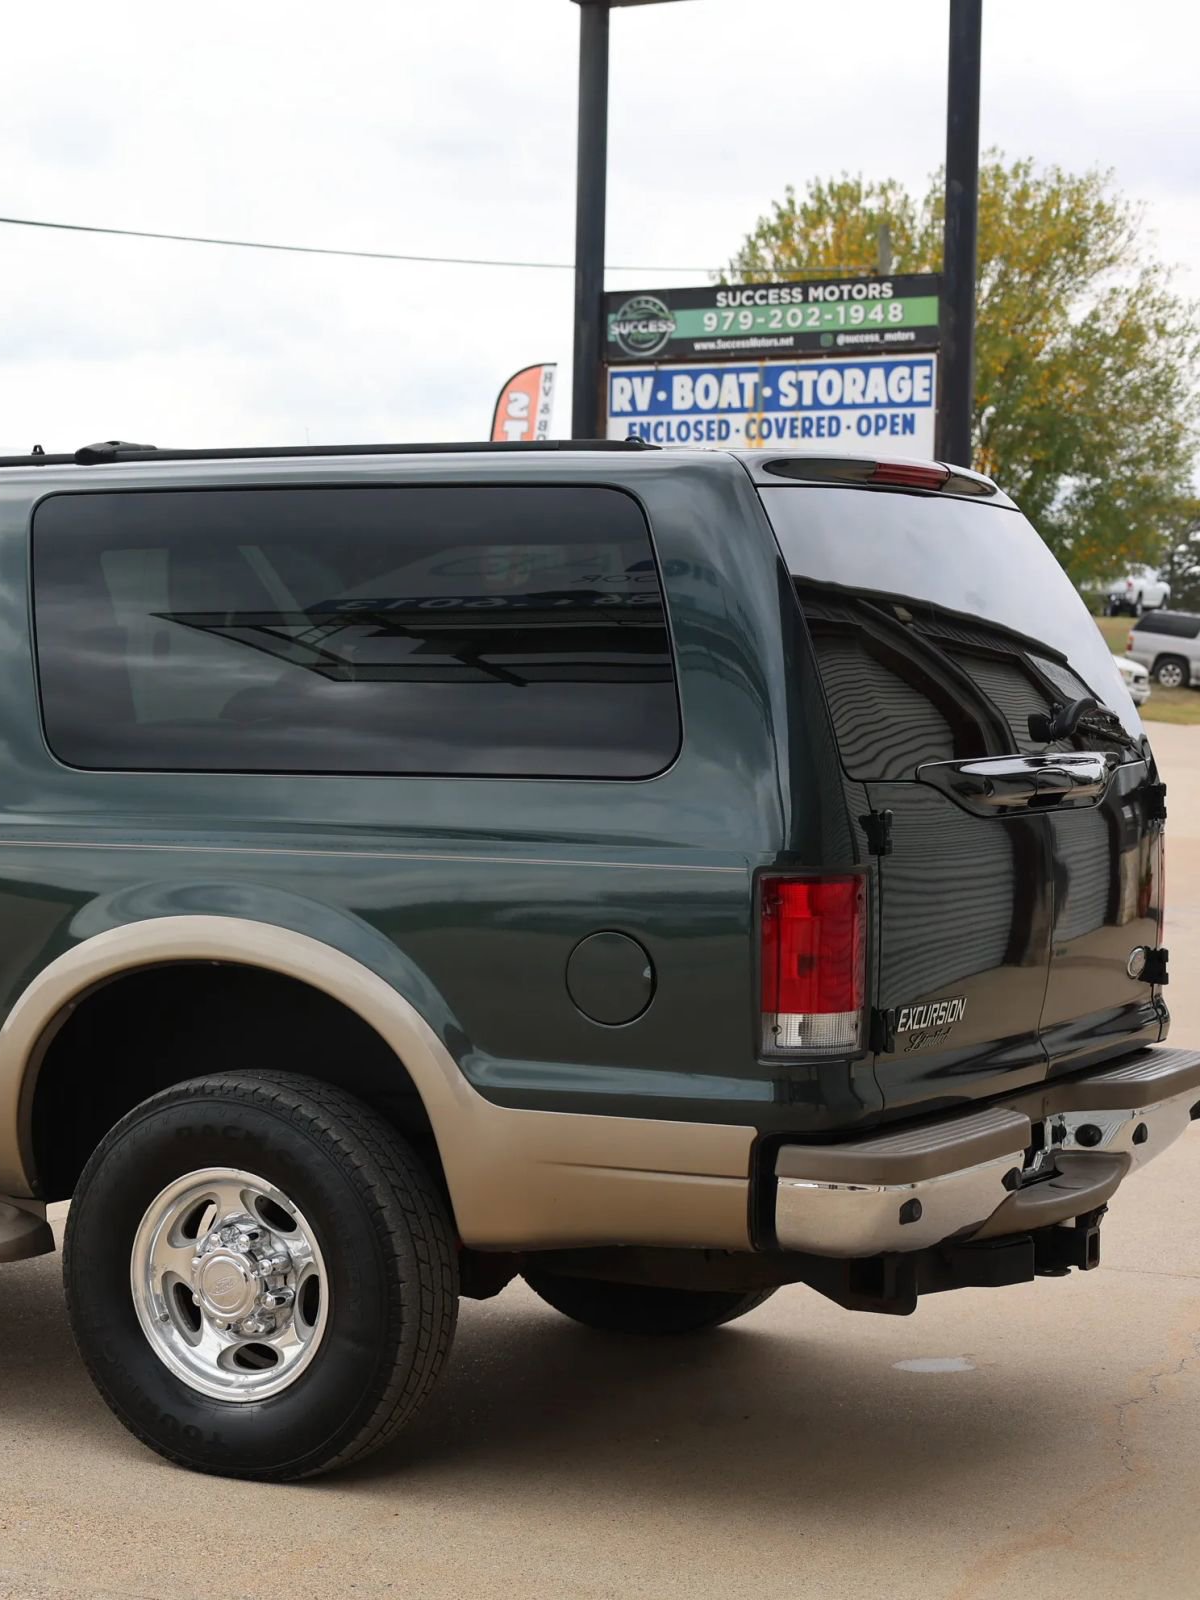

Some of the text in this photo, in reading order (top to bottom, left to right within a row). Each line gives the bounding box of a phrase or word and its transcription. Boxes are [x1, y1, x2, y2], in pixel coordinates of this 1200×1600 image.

[716, 282, 893, 308] SUCCESS MOTORS
[610, 321, 676, 335] SUCCESS
[703, 303, 903, 332] 979-202-1948
[612, 366, 931, 412] RV BOAT STORAGE
[628, 413, 915, 443] ENCLOSED COVERED OPEN
[897, 998, 967, 1032] EXCURSION
